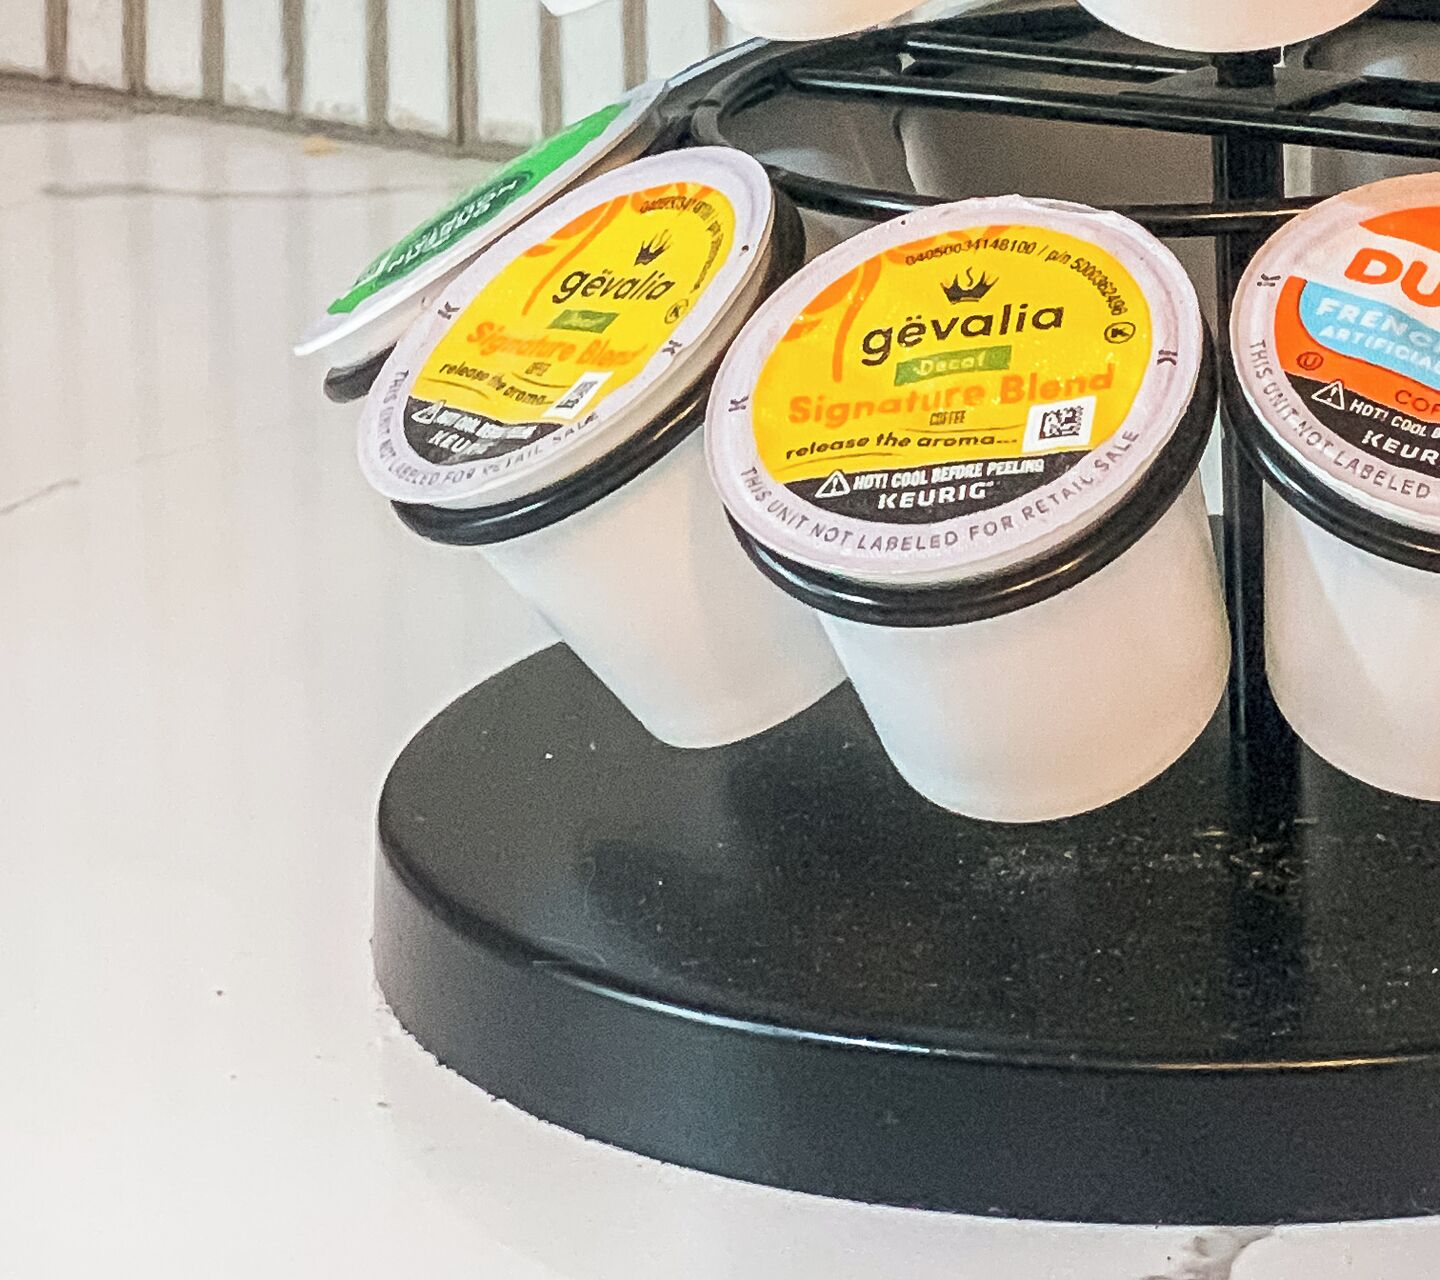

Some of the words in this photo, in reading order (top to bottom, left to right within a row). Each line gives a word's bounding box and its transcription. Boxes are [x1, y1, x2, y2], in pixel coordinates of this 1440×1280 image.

[551, 268, 676, 305] gëvalia
[466, 321, 578, 363] Signature
[861, 303, 1065, 368] gëvalia
[439, 361, 491, 382] release
[919, 352, 987, 378] Decaf
[788, 384, 979, 430] Signature
[999, 362, 1116, 406] Blend
[1248, 338, 1275, 386] THIS
[1263, 381, 1300, 423] UNIT
[1298, 419, 1335, 453] NOT
[1332, 448, 1432, 501] LABELED
[1349, 398, 1389, 423] HOT!
[1391, 415, 1429, 439] COOL
[785, 433, 870, 460] release
[875, 431, 912, 449] the
[739, 465, 771, 504] THIS
[765, 498, 811, 533] UNIT
[810, 520, 852, 549] NOT
[855, 529, 960, 552] LABELED
[967, 513, 1016, 543] FOR
[1020, 474, 1096, 523] RETAIL
[1092, 427, 1141, 474] SALE
[852, 473, 888, 491] HOT!
[890, 469, 930, 489] COOL
[930, 462, 984, 484] BEFORE
[985, 457, 1046, 478] PEELING
[876, 481, 990, 511] KEURIG
